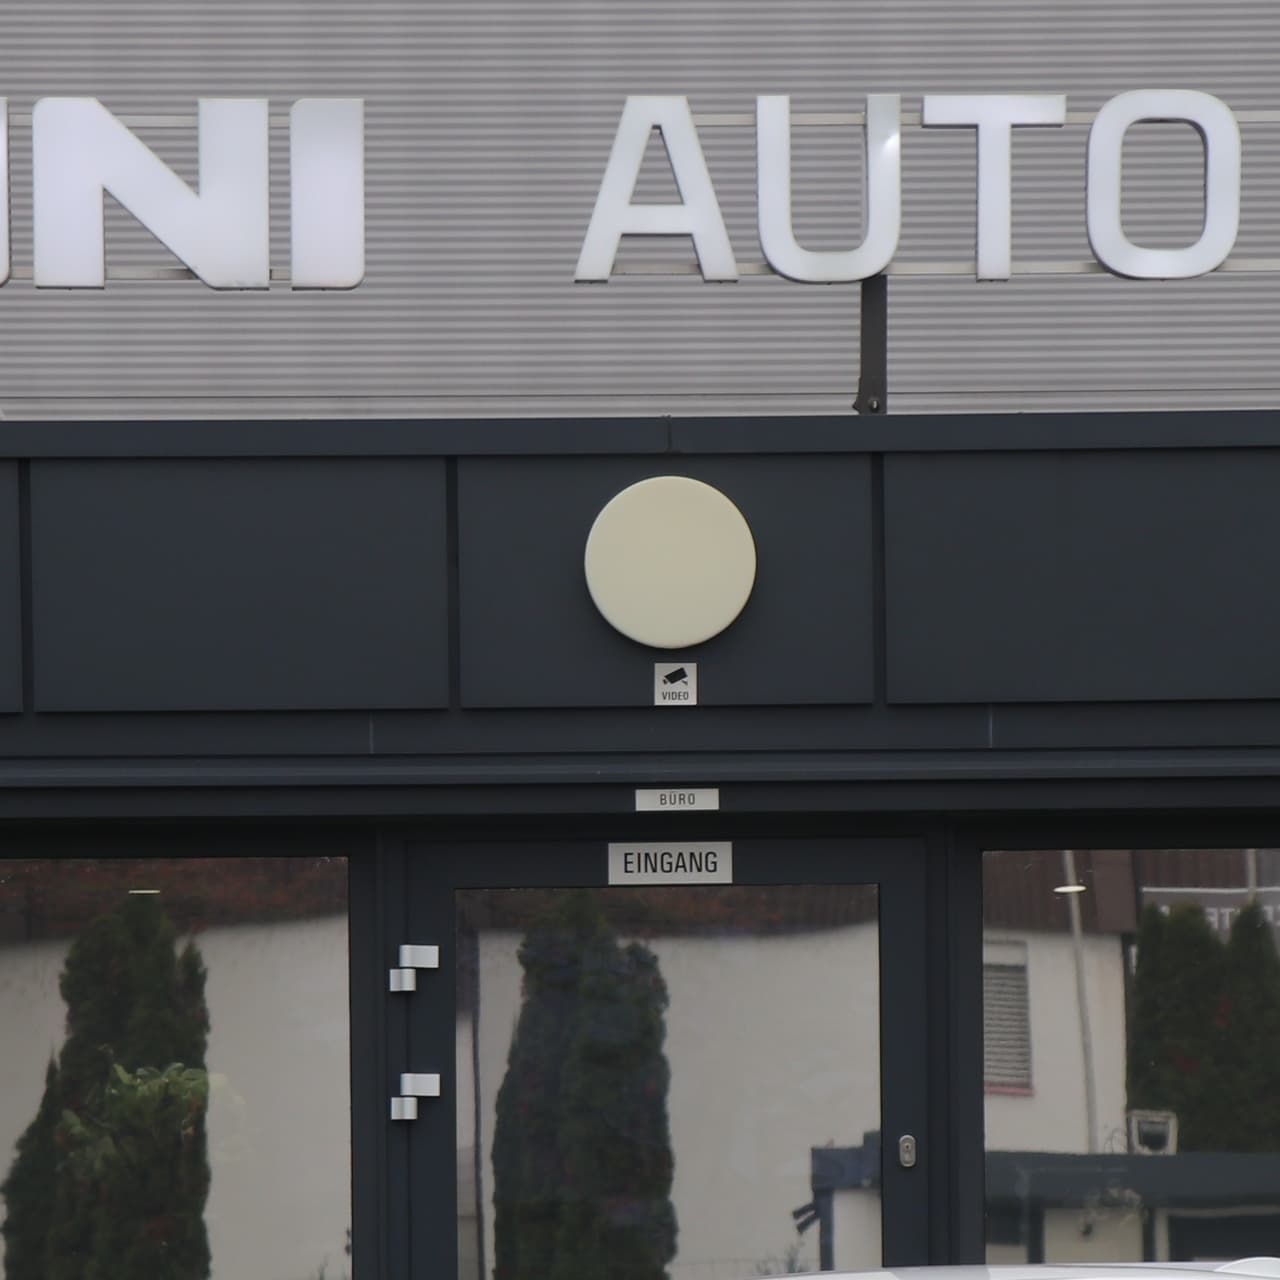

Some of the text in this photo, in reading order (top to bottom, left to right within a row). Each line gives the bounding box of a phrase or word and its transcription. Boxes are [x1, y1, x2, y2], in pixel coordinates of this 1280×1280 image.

[572, 87, 1243, 286] AUTO
[661, 691, 690, 701] VIDEO
[659, 791, 696, 806] BÜRO
[623, 851, 718, 874] EINGANG
